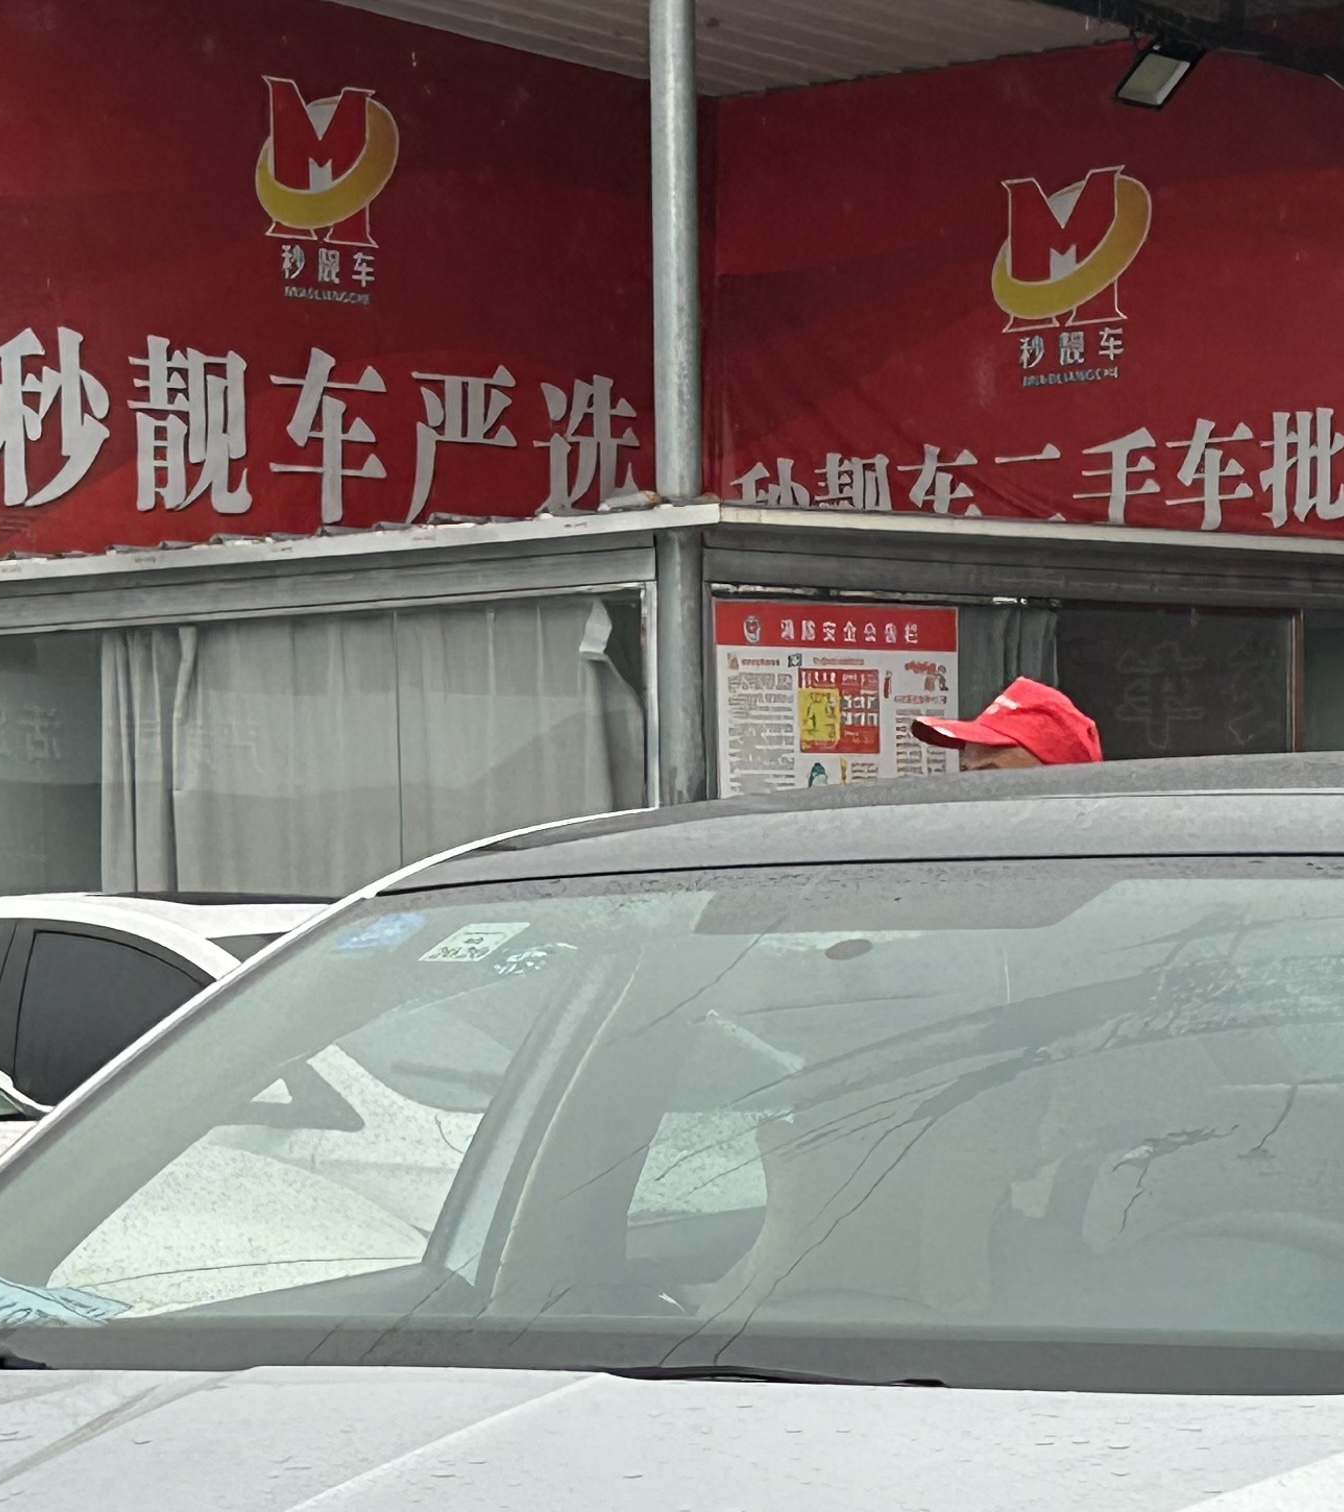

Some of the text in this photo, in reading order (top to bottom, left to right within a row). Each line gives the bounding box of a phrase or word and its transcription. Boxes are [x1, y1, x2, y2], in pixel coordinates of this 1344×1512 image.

[280, 243, 376, 288] 秒靓车
[1018, 326, 1125, 370] 秒靓车
